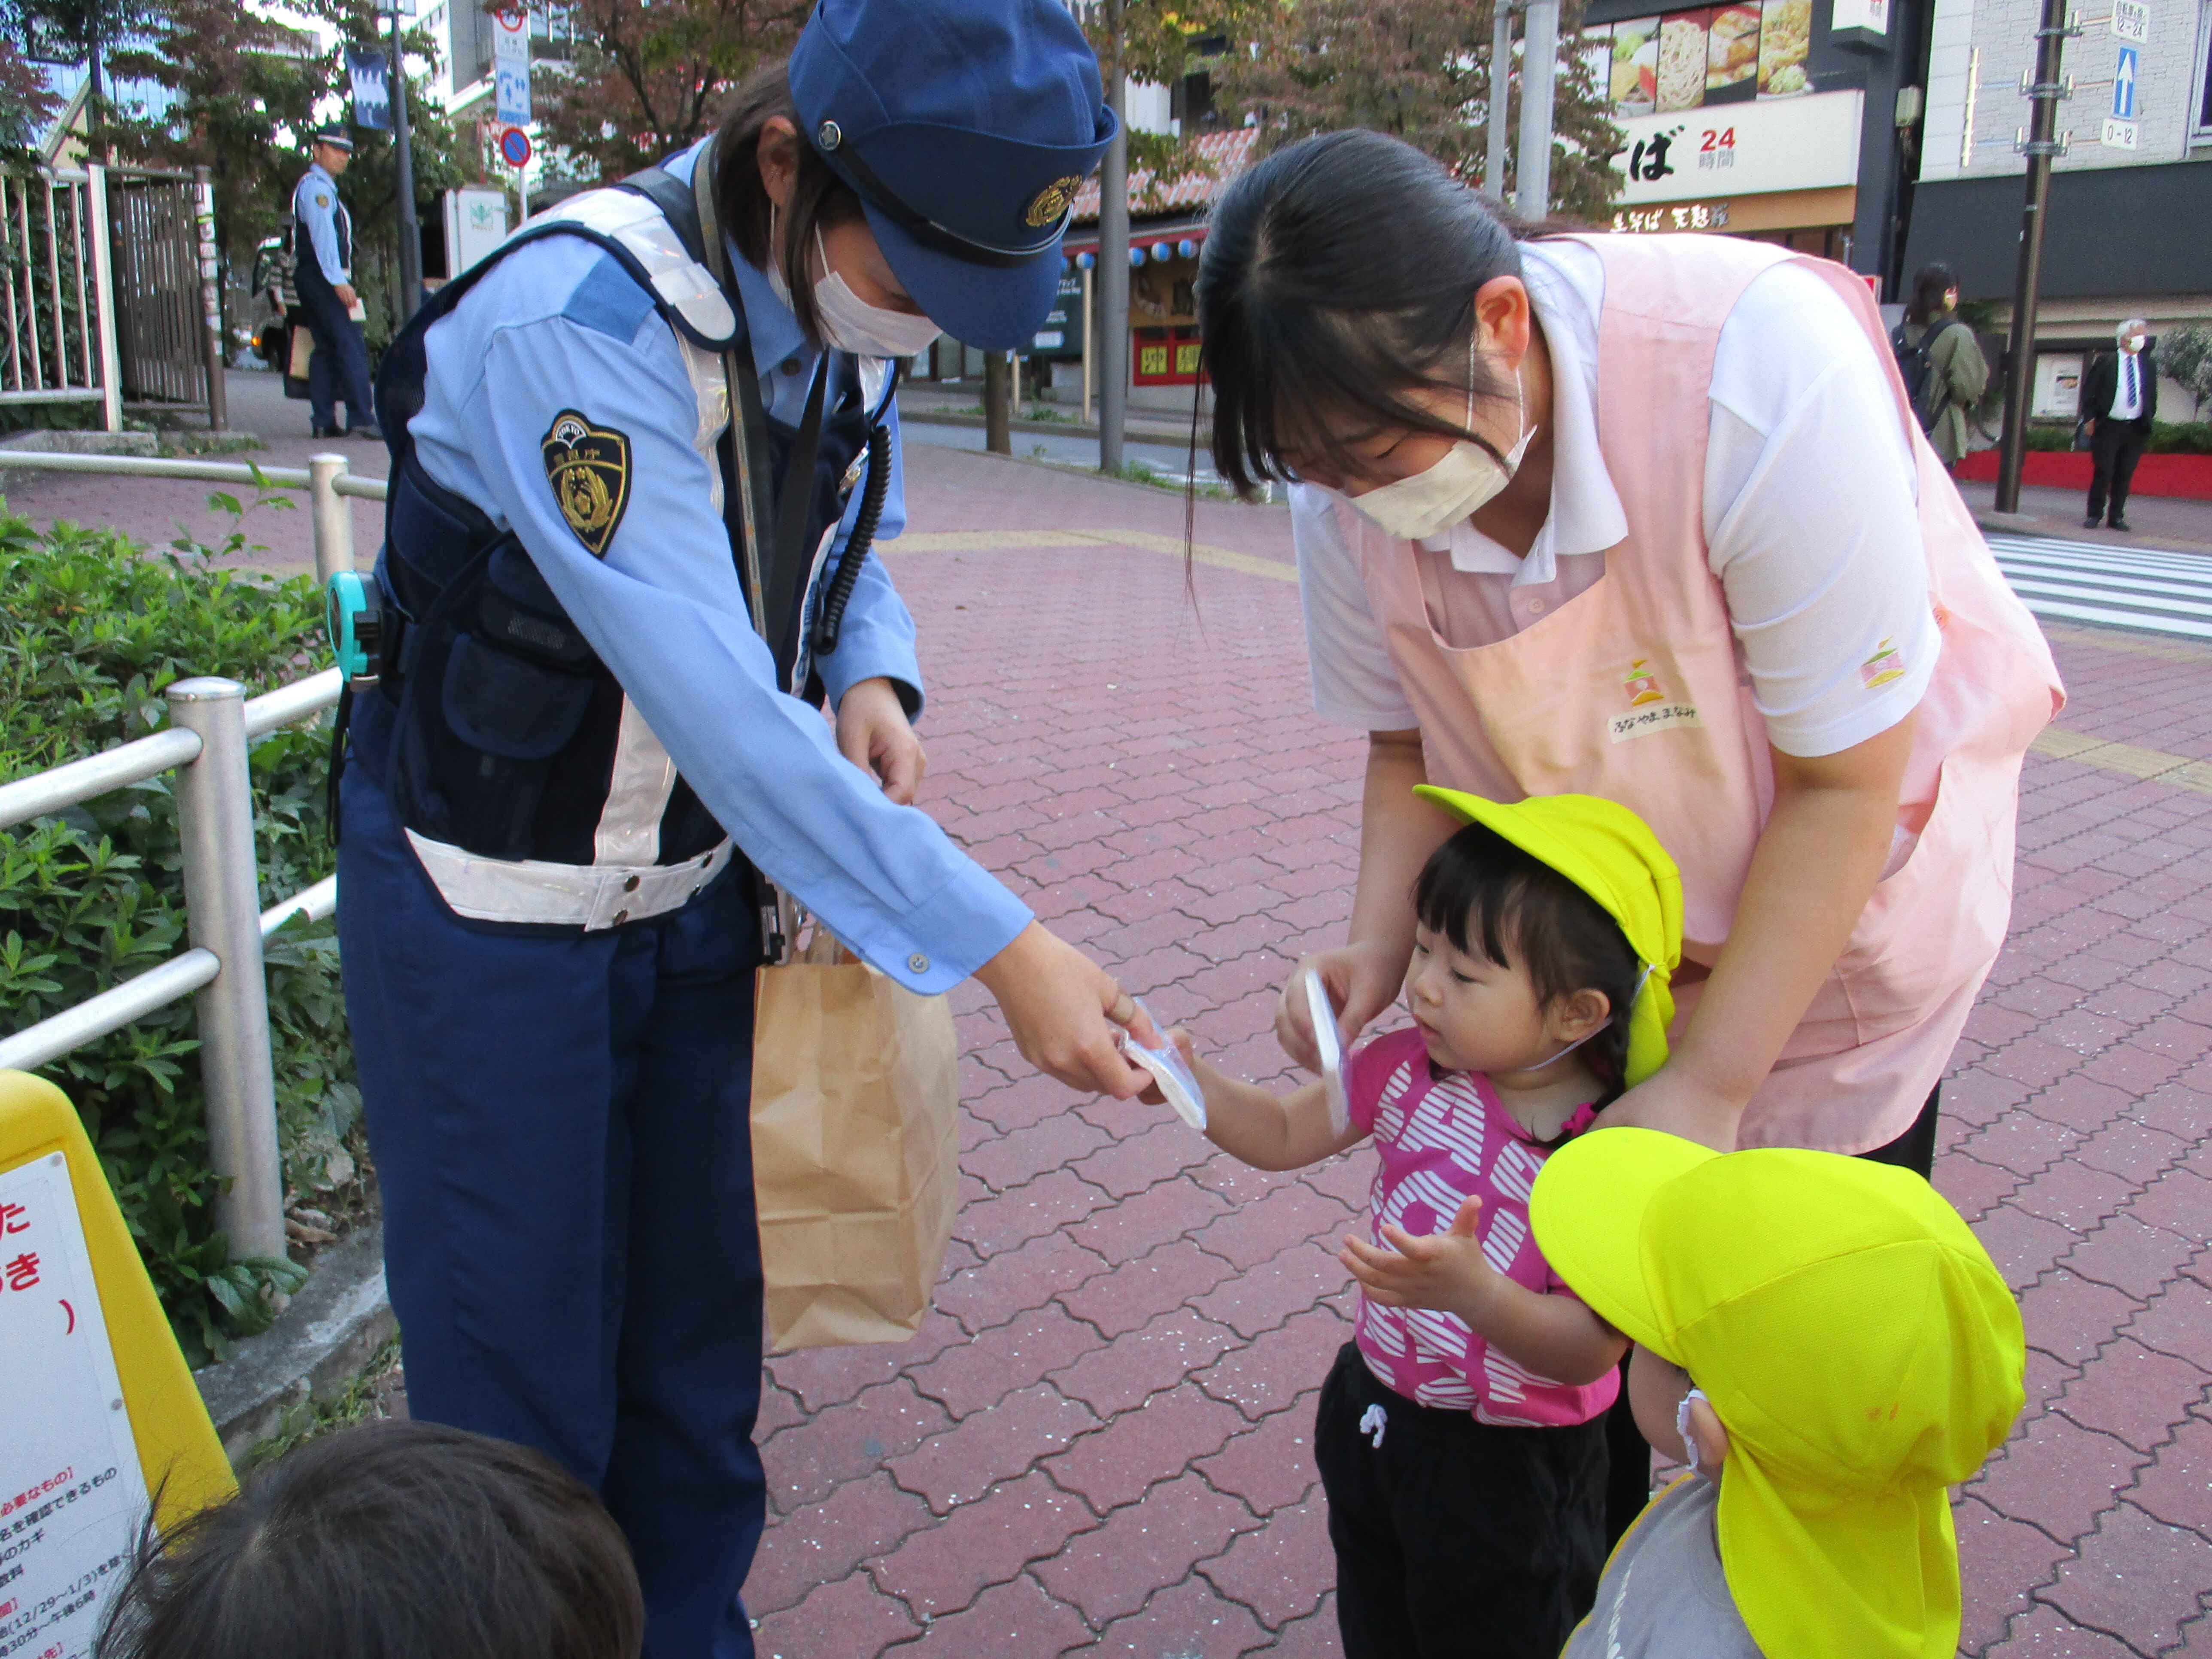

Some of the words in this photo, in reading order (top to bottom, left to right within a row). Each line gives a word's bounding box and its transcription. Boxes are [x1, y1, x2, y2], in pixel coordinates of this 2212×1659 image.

[1700, 126, 1736, 152] 24
[2107, 125, 2132, 144] 0-12
[0, 1252, 40, 1293] き
[0, 1528, 45, 1565] のカギ
